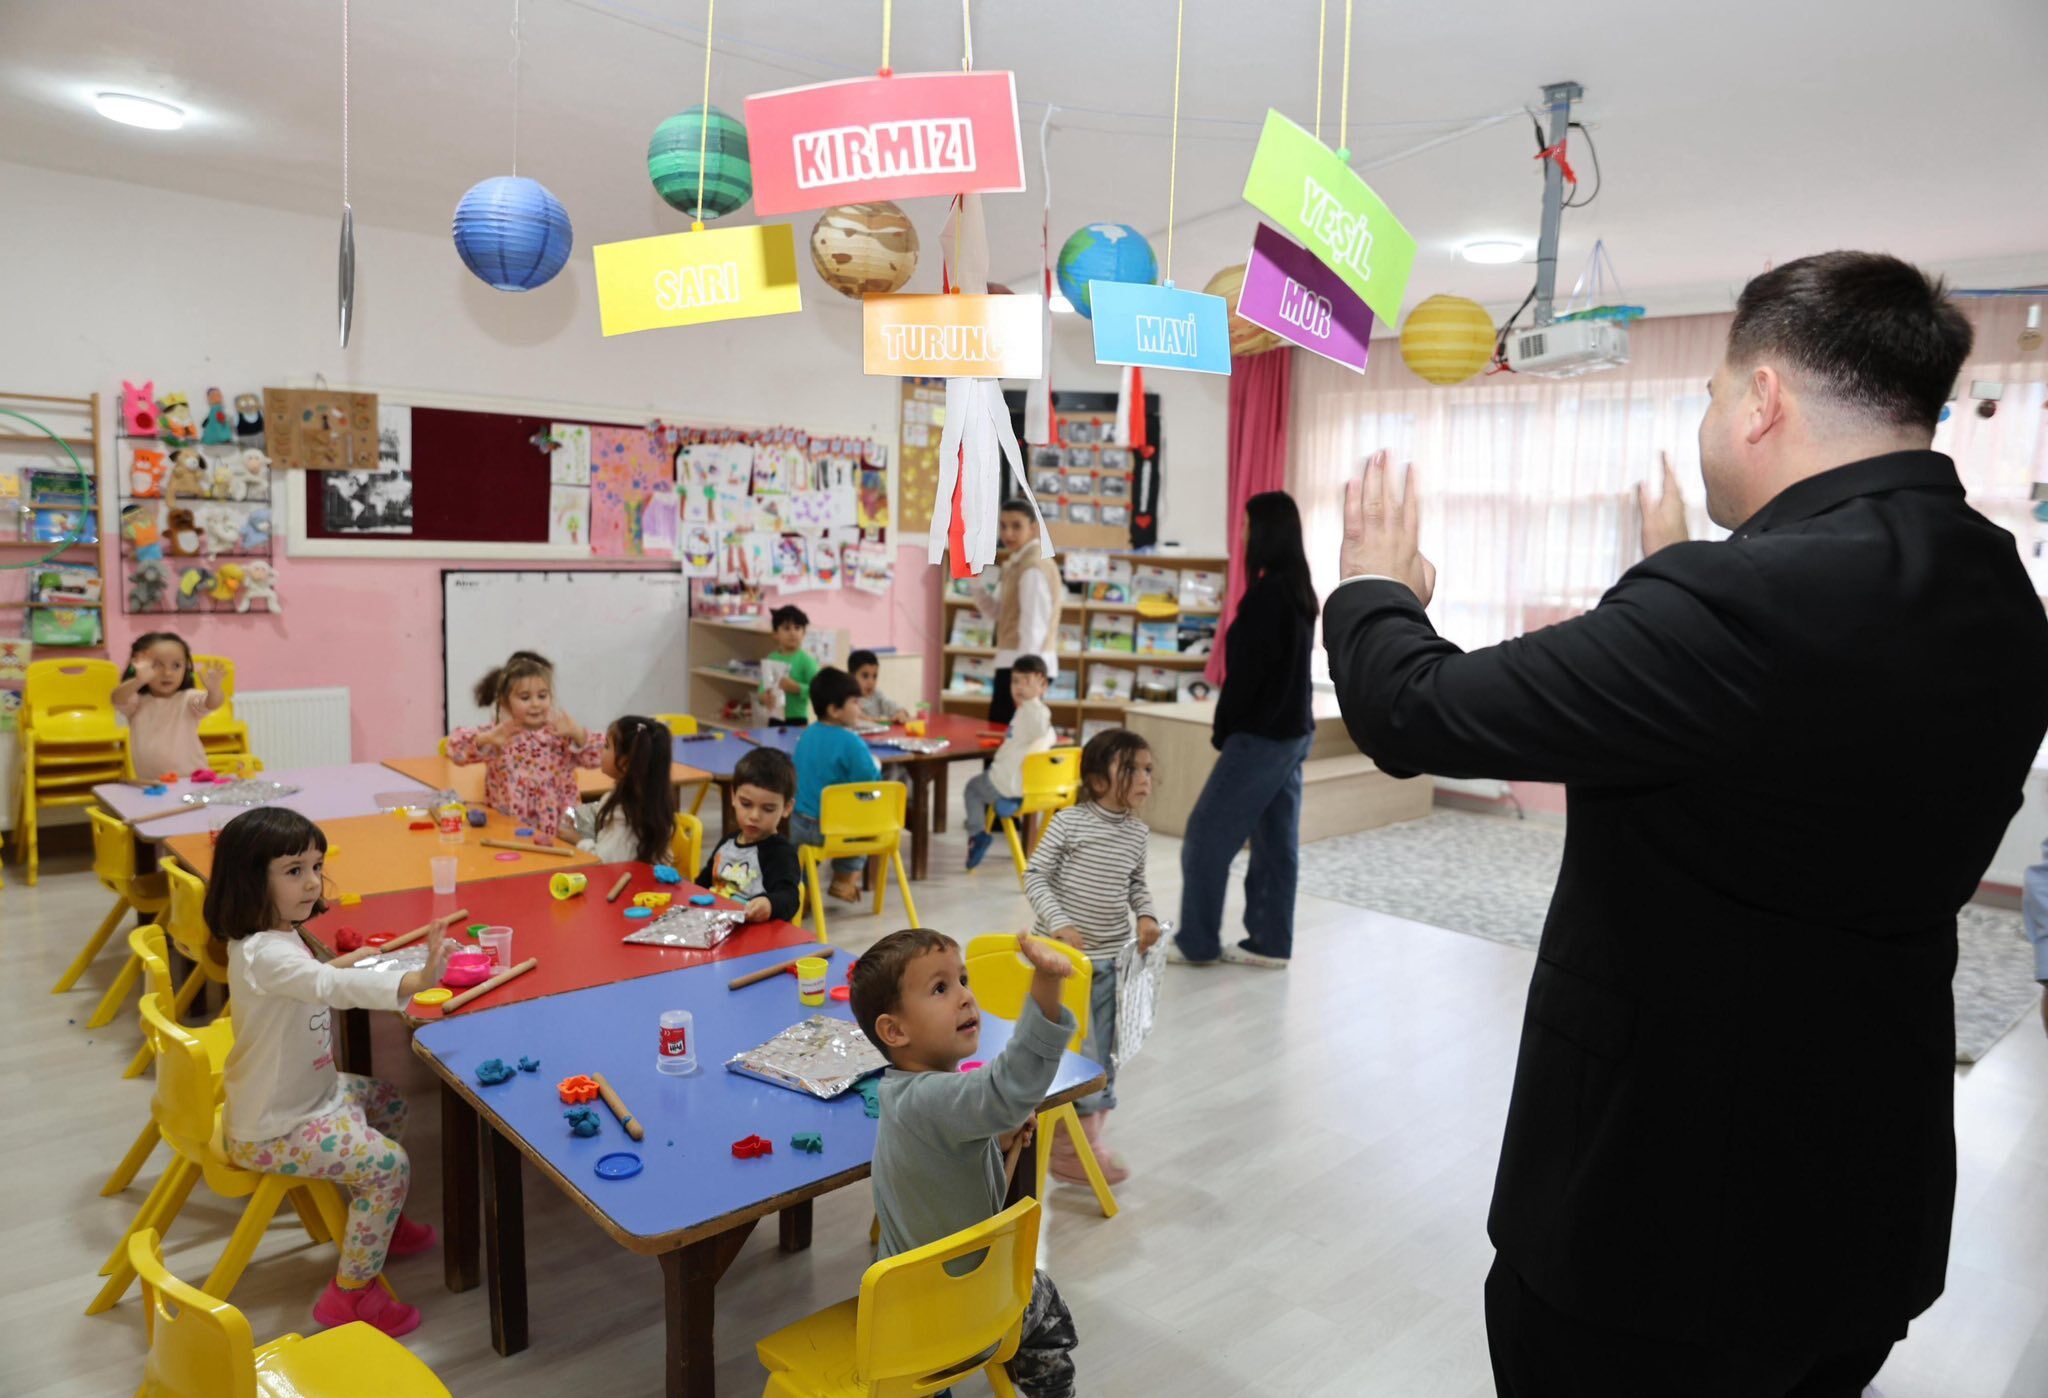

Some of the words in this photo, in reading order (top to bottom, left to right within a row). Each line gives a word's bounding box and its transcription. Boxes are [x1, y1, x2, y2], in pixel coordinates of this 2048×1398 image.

[793, 118, 976, 189] KIRMIZI
[1300, 176, 1372, 281] YEŞİL
[656, 262, 739, 310] SARI
[1279, 278, 1332, 339] MOR
[1136, 312, 1197, 357] MAVİ
